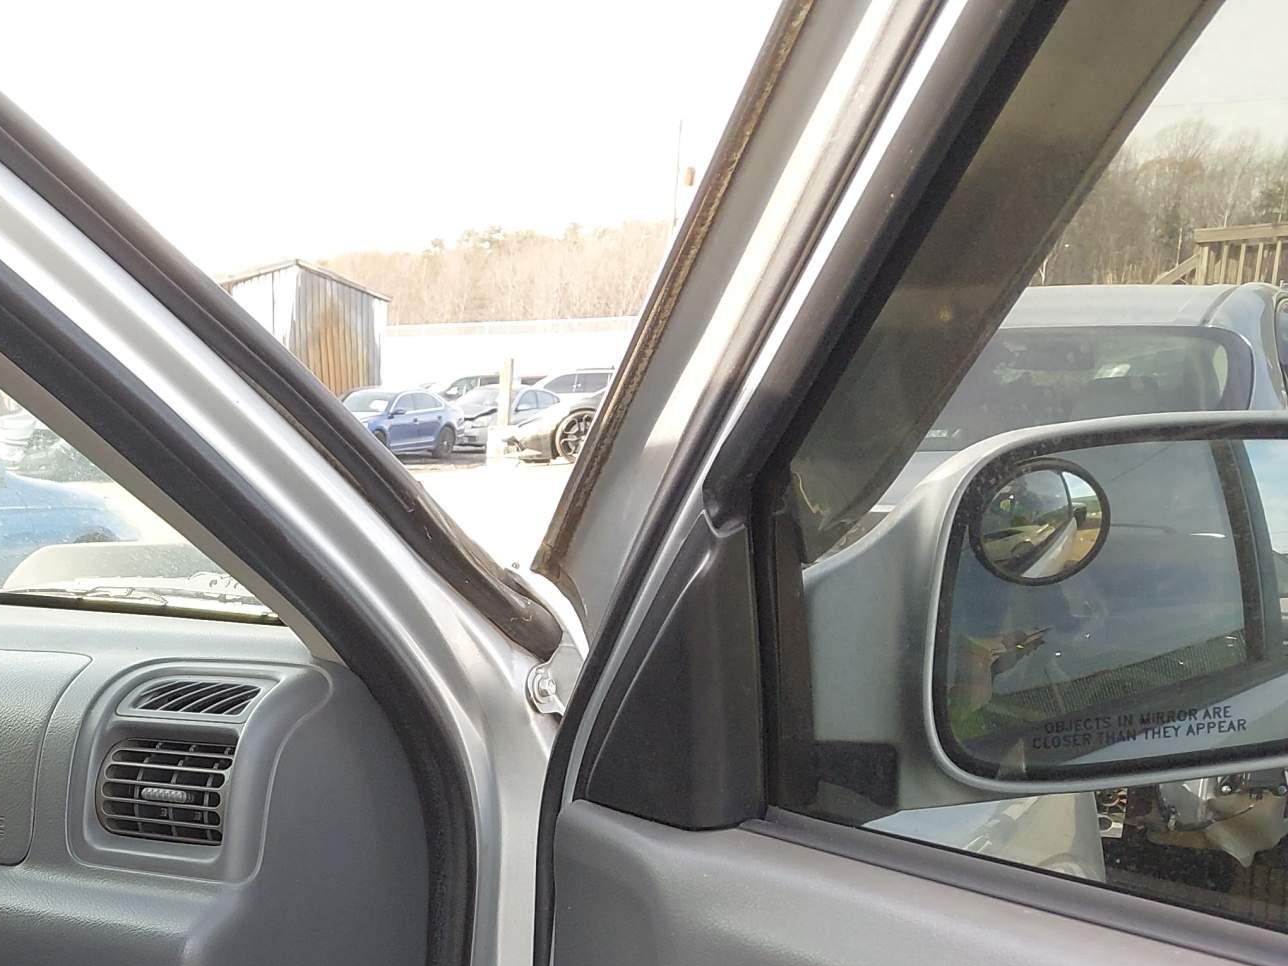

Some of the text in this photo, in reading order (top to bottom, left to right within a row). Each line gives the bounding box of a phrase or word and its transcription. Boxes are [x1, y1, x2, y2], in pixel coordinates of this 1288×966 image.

[1032, 718, 1247, 749] CLOSER THAN THEY APPEAR
[1044, 705, 1232, 734] OBJECTS IN MIRROR ARE
